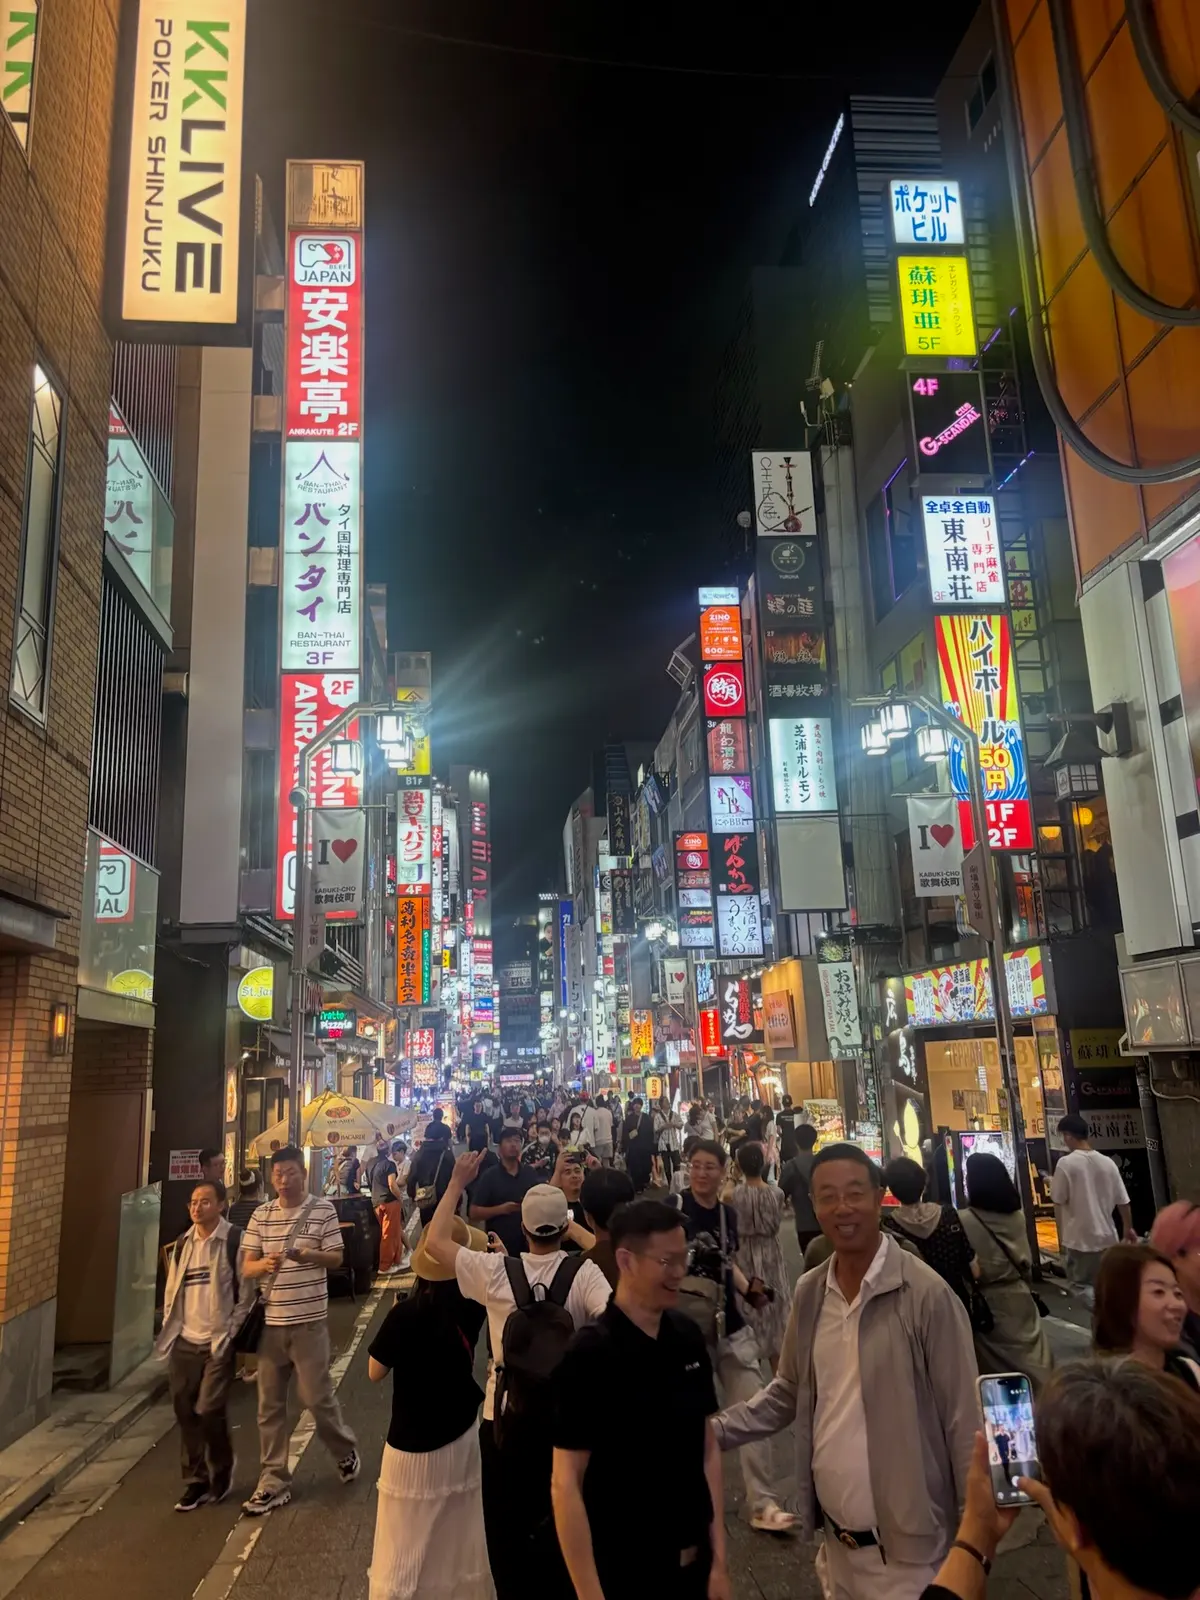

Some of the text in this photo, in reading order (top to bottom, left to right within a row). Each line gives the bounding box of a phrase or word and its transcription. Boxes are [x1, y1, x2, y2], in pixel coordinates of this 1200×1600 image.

[141, 18, 173, 293] POKER SHINJUKU
[174, 19, 231, 295] KKLIVE
[894, 185, 957, 213] ポケット
[911, 215, 948, 242] ビル
[299, 270, 351, 283] JAPAN
[917, 336, 941, 350] 5F
[300, 288, 350, 424] 安楽亭
[913, 378, 939, 396] 4F
[288, 421, 359, 436] ANRAKUTEI 2F
[919, 410, 981, 456] G-SCANDAL
[297, 483, 348, 495] RESTAURANT
[303, 480, 342, 489] BAN-THAI
[925, 500, 991, 514] 全卓全自動
[336, 503, 353, 614] タイ国料理専門店
[941, 517, 974, 601] 東南荘
[982, 517, 999, 583] リーチ麻雀
[293, 502, 332, 623] バンタイ
[971, 543, 987, 593] 専門店
[289, 640, 352, 648] RESTAURANT
[297, 631, 346, 639] BAN-THAI
[305, 651, 335, 665] 3F
[330, 680, 355, 695] 2F
[967, 618, 1006, 746] ハイボール
[793, 723, 811, 804] 芝浦ホルモン
[979, 748, 1010, 769] 50
[985, 770, 1007, 791] 円
[985, 803, 1015, 823] 1F
[917, 825, 931, 850] I
[987, 828, 1019, 847] 2F
[318, 839, 330, 866] I
[919, 870, 961, 879] KABUKI-CHO
[919, 878, 961, 889] 歌舞伎町
[314, 894, 356, 905] 歌舞伎町
[315, 886, 356, 894] KABUKI-CHO
[404, 885, 422, 896] 4F
